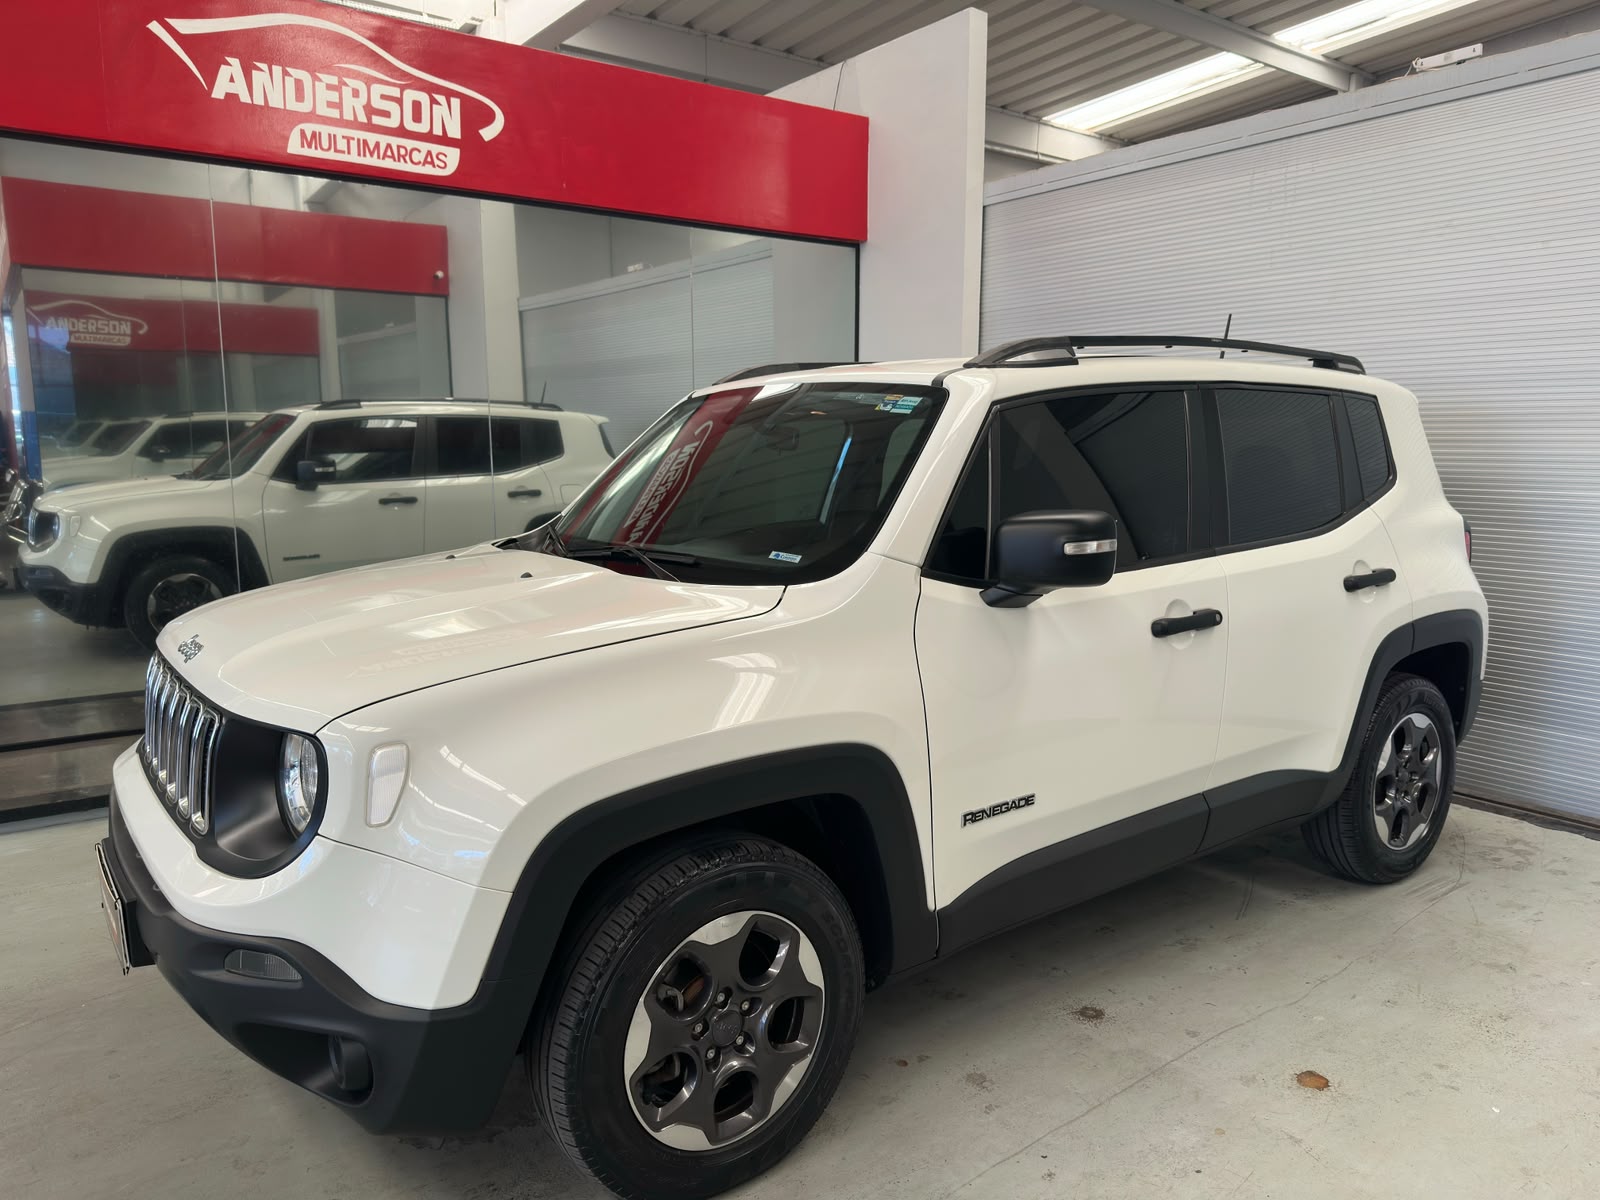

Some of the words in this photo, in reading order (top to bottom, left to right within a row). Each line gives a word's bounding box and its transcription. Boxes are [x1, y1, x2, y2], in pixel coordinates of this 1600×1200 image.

[211, 56, 462, 140] ANDERSON
[299, 128, 449, 171] MULTIMARCAS
[45, 316, 132, 335] ANDERSON
[961, 793, 1035, 828] RENEGADE
